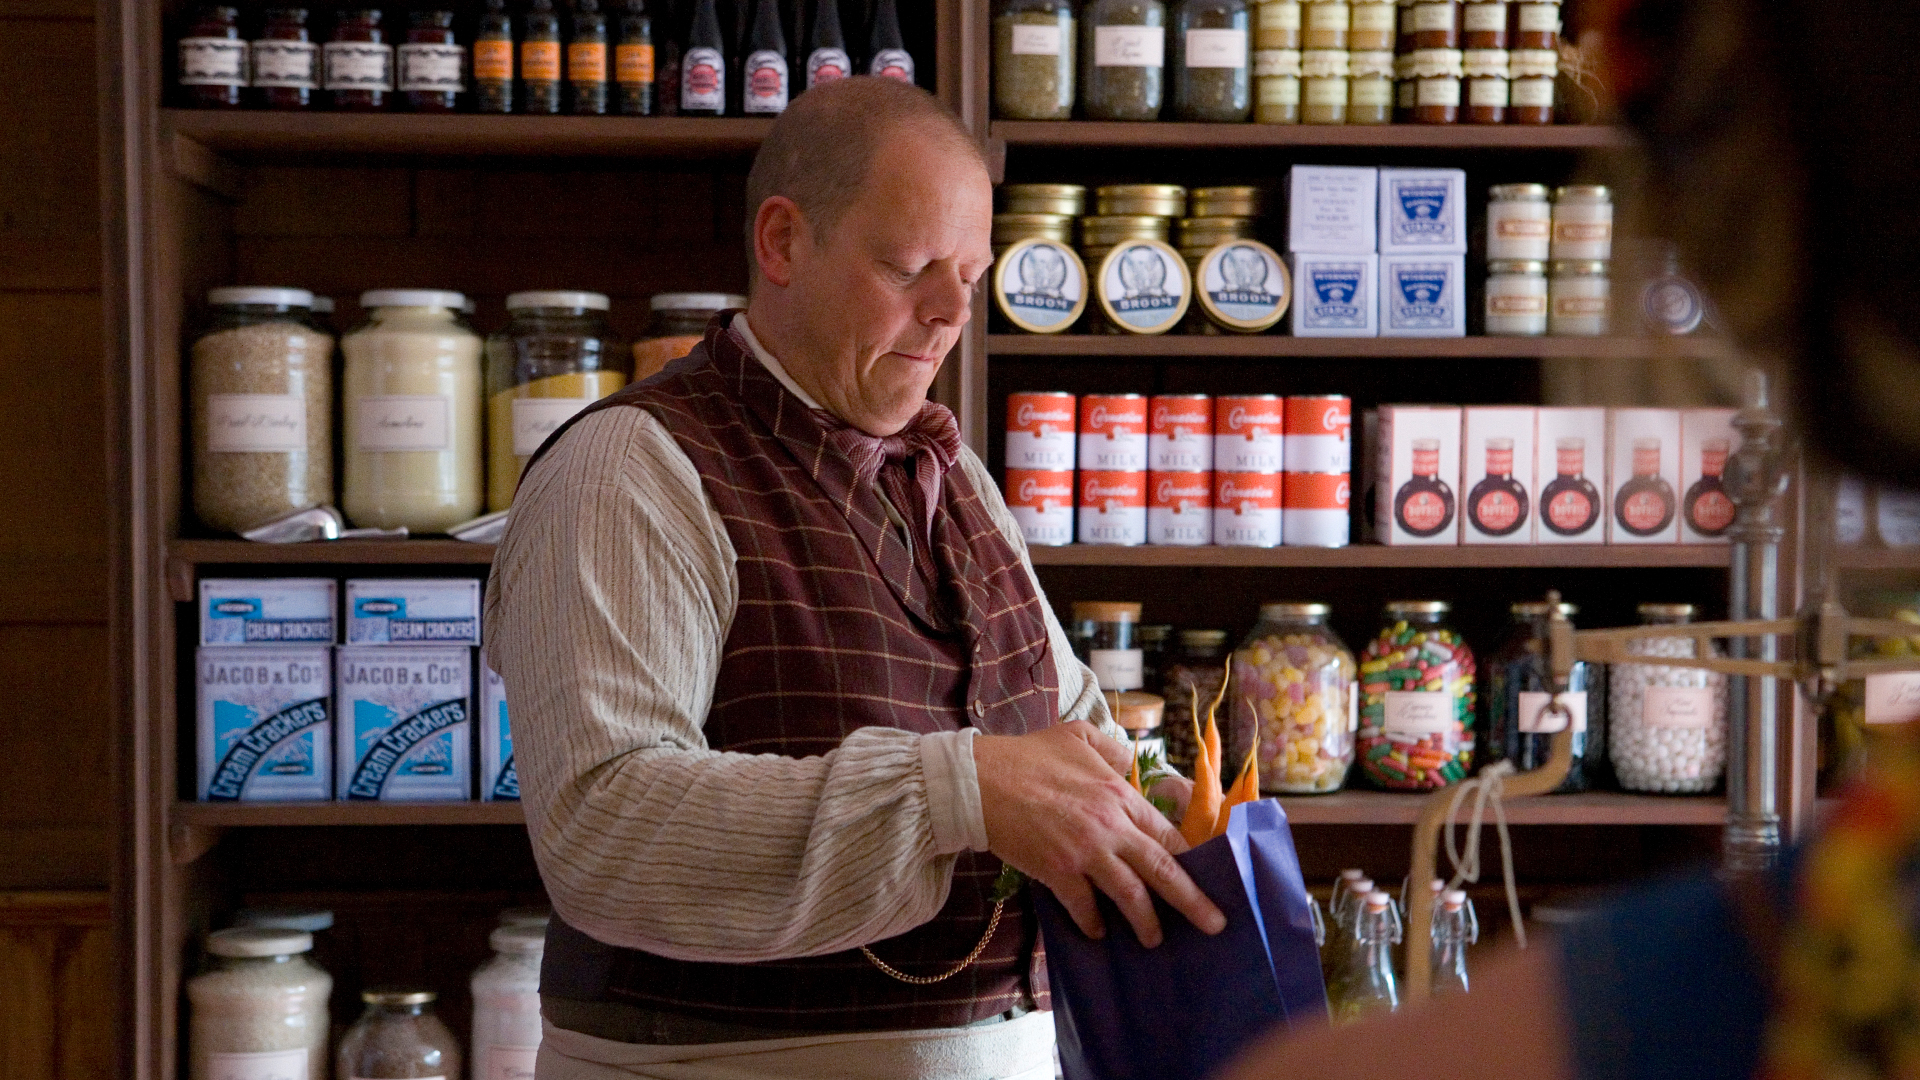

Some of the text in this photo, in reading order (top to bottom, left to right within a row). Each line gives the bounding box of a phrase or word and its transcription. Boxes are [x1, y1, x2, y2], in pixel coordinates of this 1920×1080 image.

[1024, 452, 1066, 465] MILK
[1097, 453, 1138, 466] MILK
[1159, 454, 1200, 467] MILK
[1235, 455, 1277, 467] MILK
[1027, 527, 1066, 539] MILK
[1091, 527, 1132, 539] MILK
[1164, 528, 1208, 540] MILK
[1225, 529, 1268, 541] MILK
[246, 622, 331, 640] CREAM CRACKERS
[390, 622, 474, 640] CREAM CRACKERS
[204, 663, 269, 685] JACOB
[273, 671, 283, 684] &
[344, 663, 408, 685] JACOB
[412, 671, 422, 684] &
[210, 701, 327, 798] Cream Crackers
[350, 702, 465, 797] Cream Crackers
